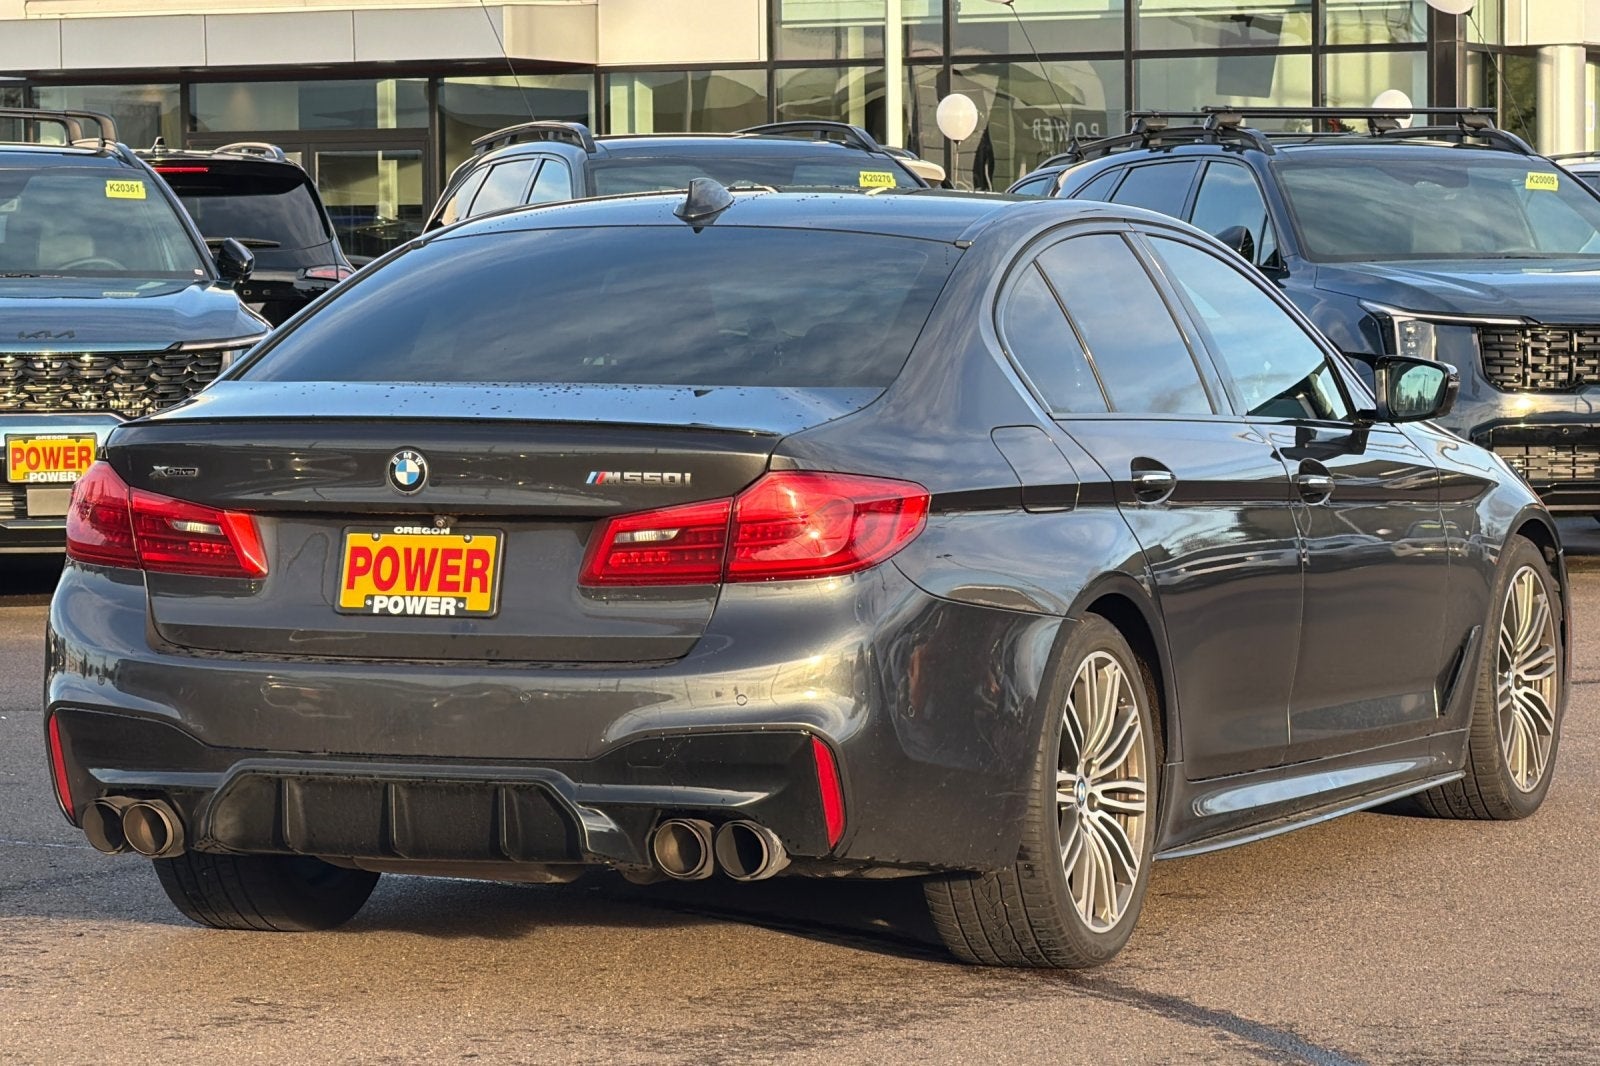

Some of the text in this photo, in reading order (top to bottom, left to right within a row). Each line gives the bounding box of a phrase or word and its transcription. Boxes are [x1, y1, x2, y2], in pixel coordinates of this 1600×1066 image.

[862, 174, 892, 183] K20270
[109, 183, 140, 193] K20361
[11, 445, 92, 471] POWER
[29, 471, 77, 482] POWER
[393, 526, 450, 535] OREGON
[346, 546, 491, 593] POWER
[372, 595, 458, 616] POWER
